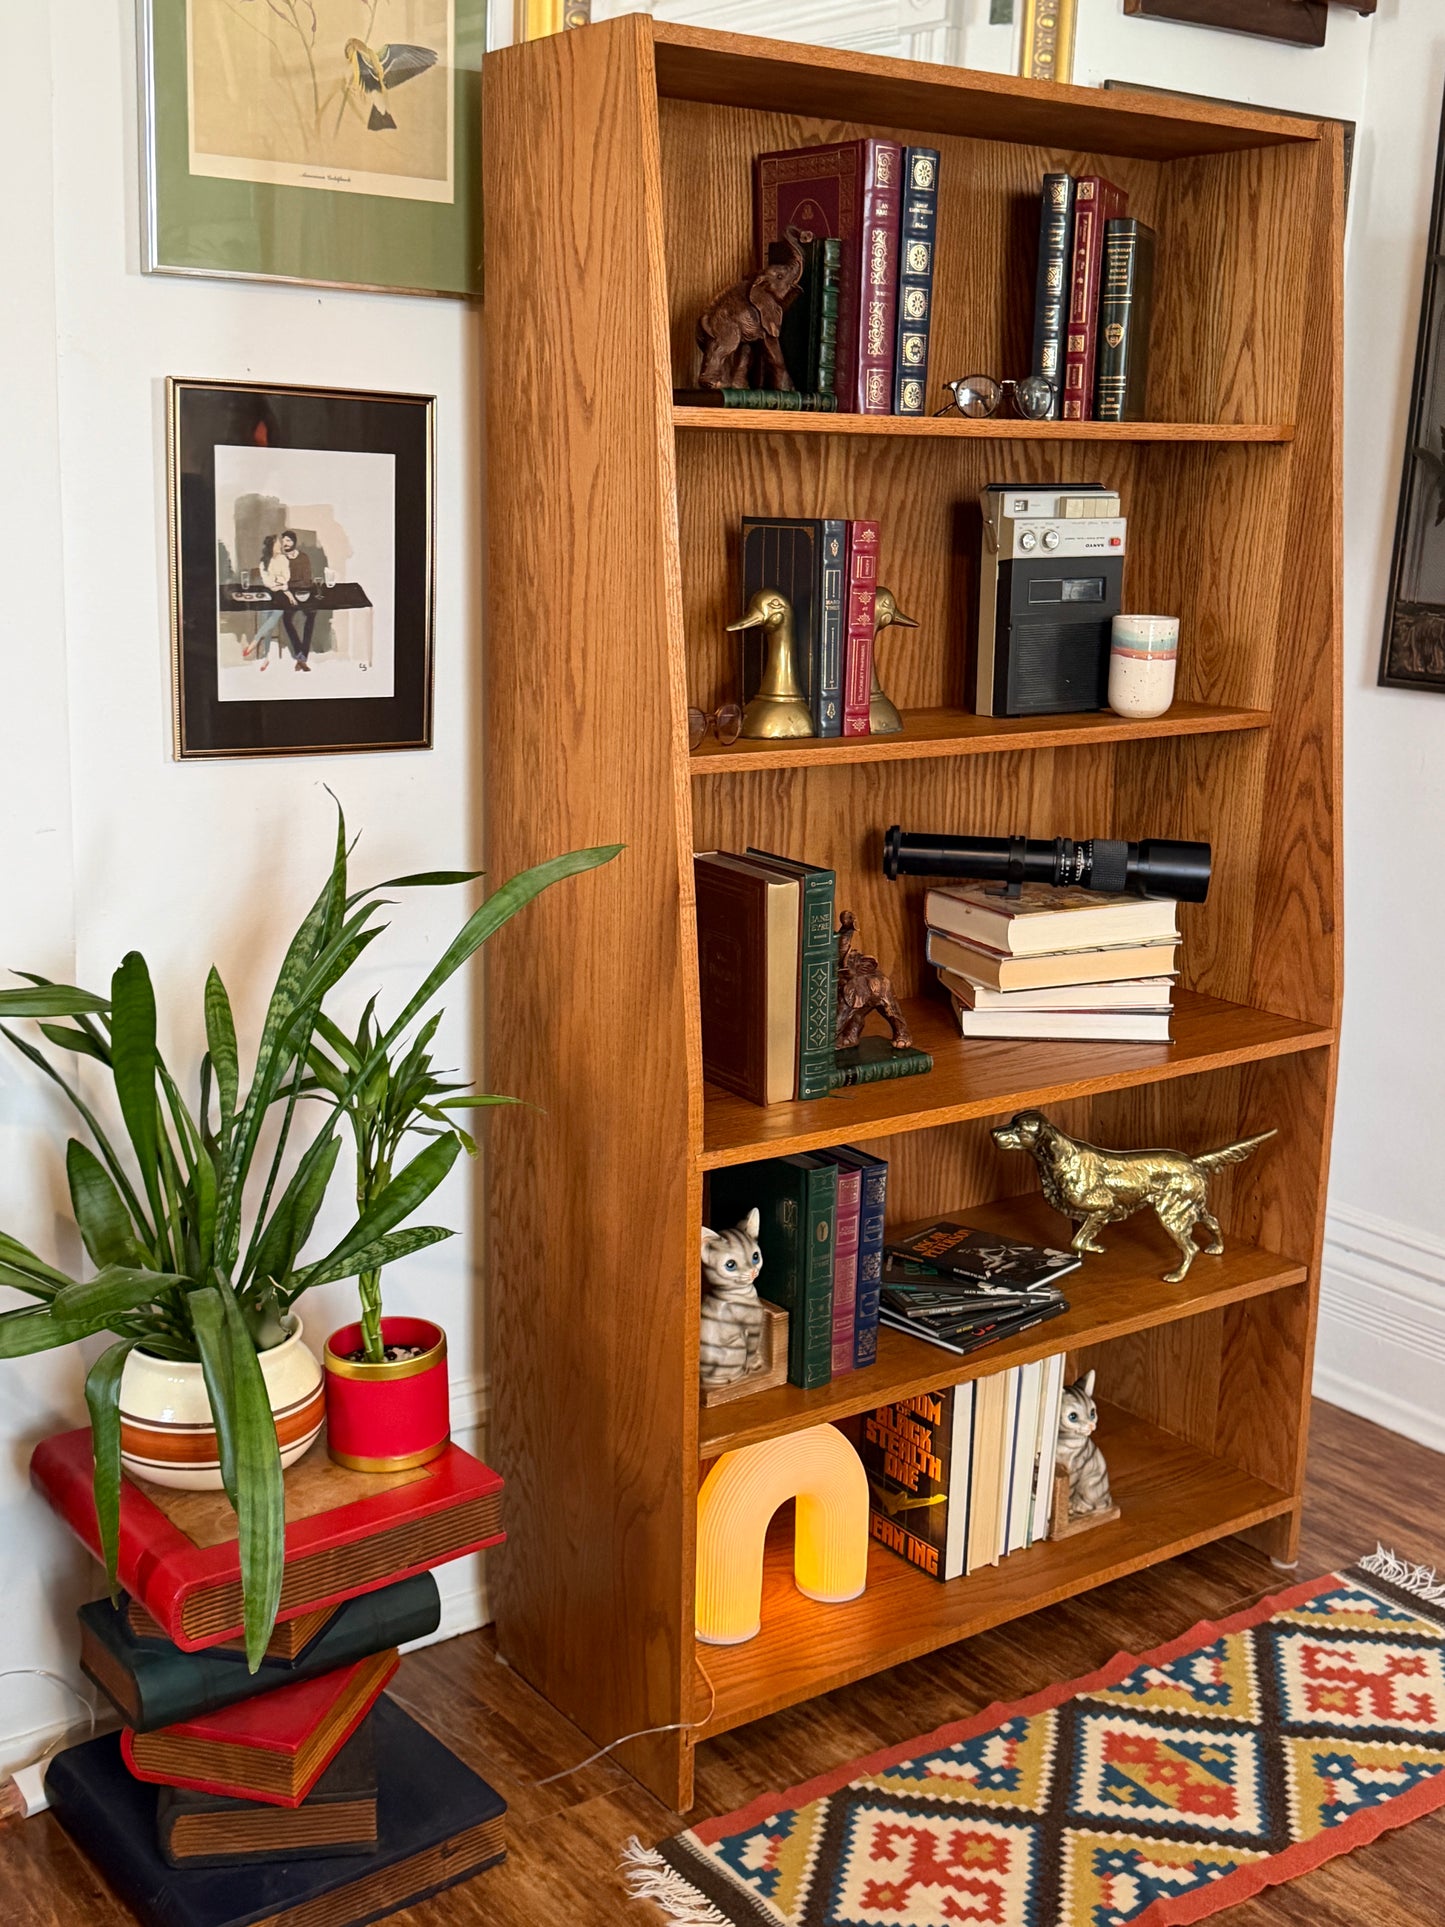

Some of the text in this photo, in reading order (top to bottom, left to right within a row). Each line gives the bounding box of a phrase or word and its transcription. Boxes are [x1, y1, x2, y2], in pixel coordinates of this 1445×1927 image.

[810, 914, 830, 924] JANE
[811, 923, 830, 932] EYRE
[912, 1232, 950, 1252] OSCAR
[896, 1403, 911, 1417] OF
[876, 1406, 932, 1453] BLACK
[866, 1417, 942, 1483] STEALTH
[884, 1451, 919, 1492] ONE
[869, 1510, 939, 1577] EAN ING
